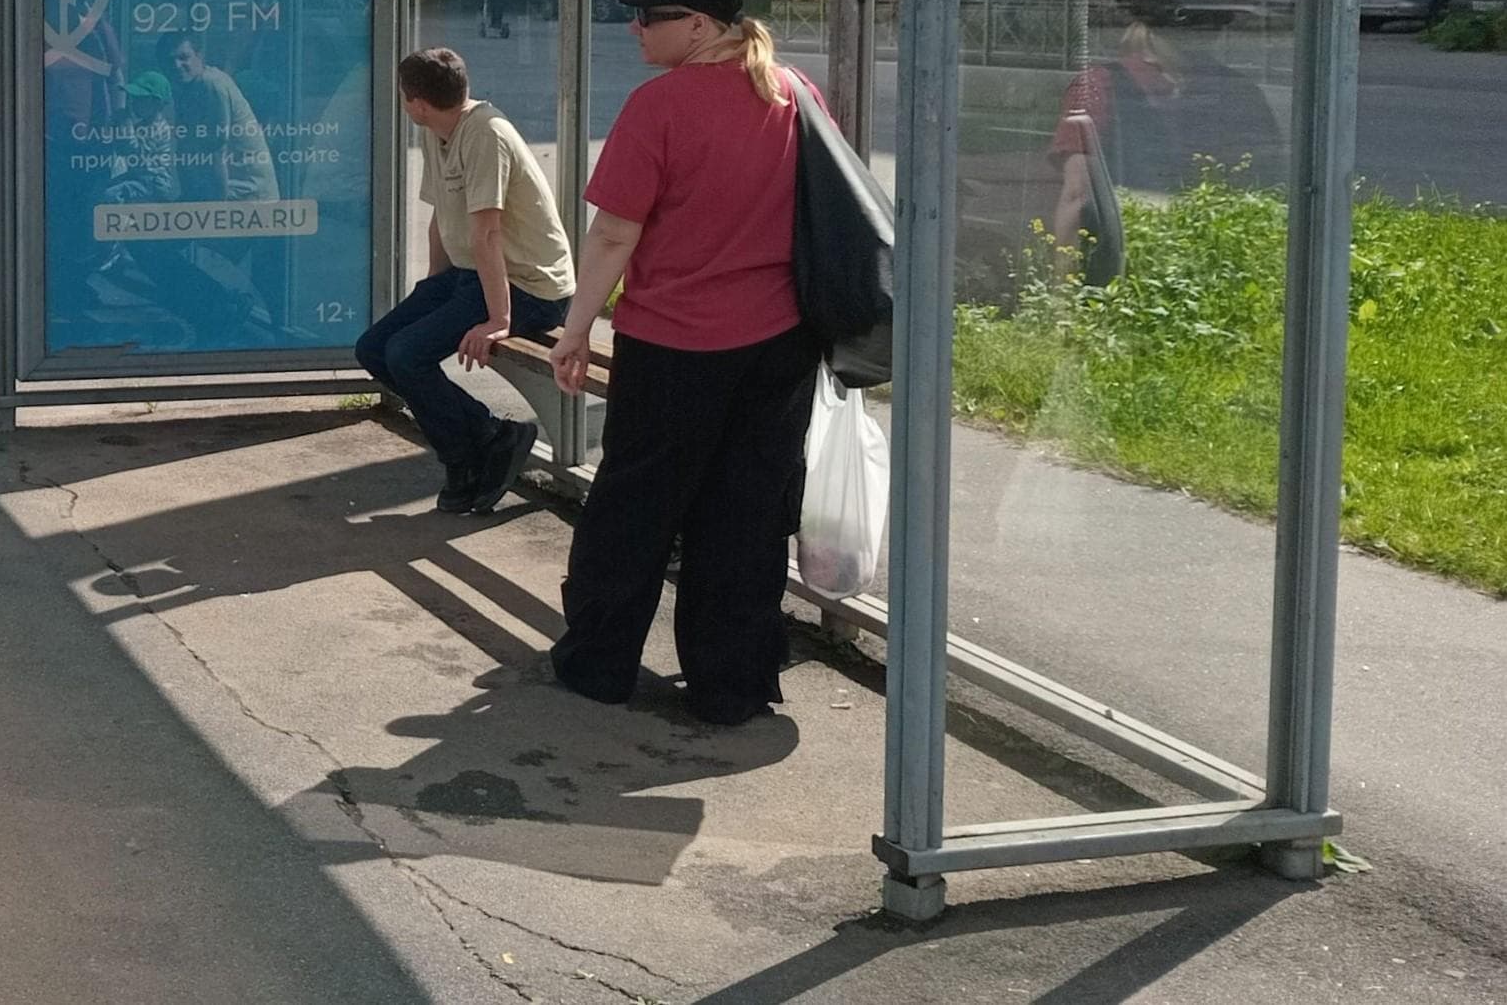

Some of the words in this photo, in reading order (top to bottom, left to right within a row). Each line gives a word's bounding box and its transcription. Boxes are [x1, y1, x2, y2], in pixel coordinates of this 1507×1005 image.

[133, 1, 212, 33] 92.9
[228, 2, 281, 31] FM
[71, 121, 188, 144] Слушайте
[196, 124, 208, 138] в
[215, 120, 340, 139] мобильном
[71, 152, 213, 173] приложении
[222, 152, 234, 165] и
[243, 151, 270, 165] на
[278, 146, 340, 165] сайте
[105, 208, 307, 234] RADIOVERA.RU
[316, 301, 356, 323] 12+
